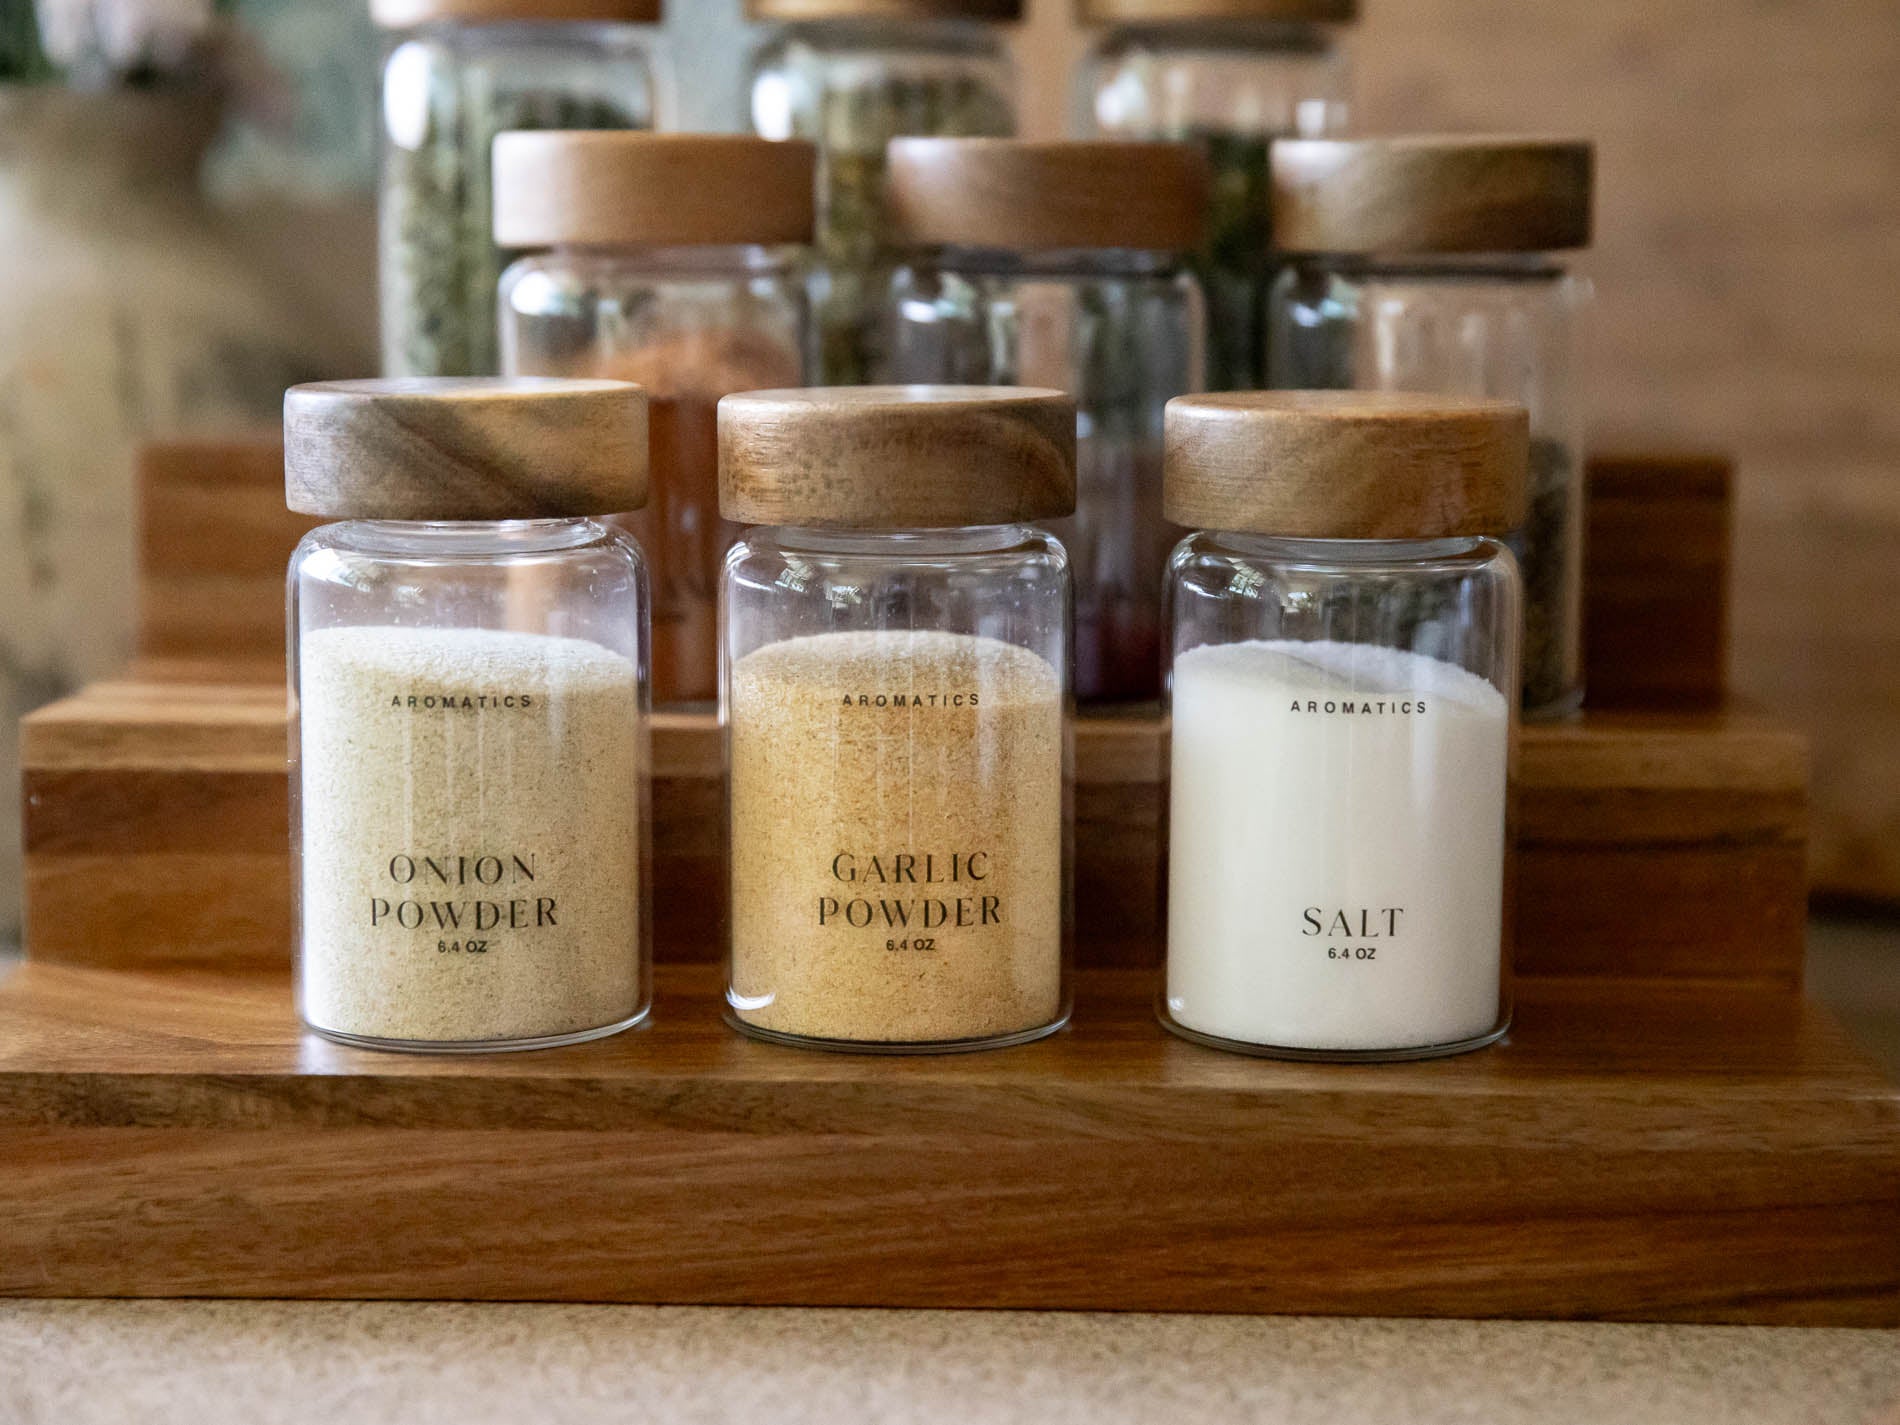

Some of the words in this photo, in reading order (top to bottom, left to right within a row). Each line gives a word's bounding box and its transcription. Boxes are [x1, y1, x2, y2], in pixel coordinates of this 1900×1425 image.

[391, 694, 533, 709] AROMATICS
[842, 693, 979, 707] AROMATICS
[1290, 700, 1427, 715] AROMATICS
[389, 853, 536, 886] ONION
[831, 850, 990, 884] GARLIC
[371, 897, 559, 931] POWDER
[819, 895, 1002, 929] POWDER
[1301, 907, 1405, 938] SALT
[437, 939, 461, 954] 6.4
[465, 940, 488, 954] OZ
[885, 938, 908, 952] 6.4
[912, 938, 936, 952] OZ
[1327, 947, 1350, 960] 6.4
[1355, 947, 1377, 961] OZ
